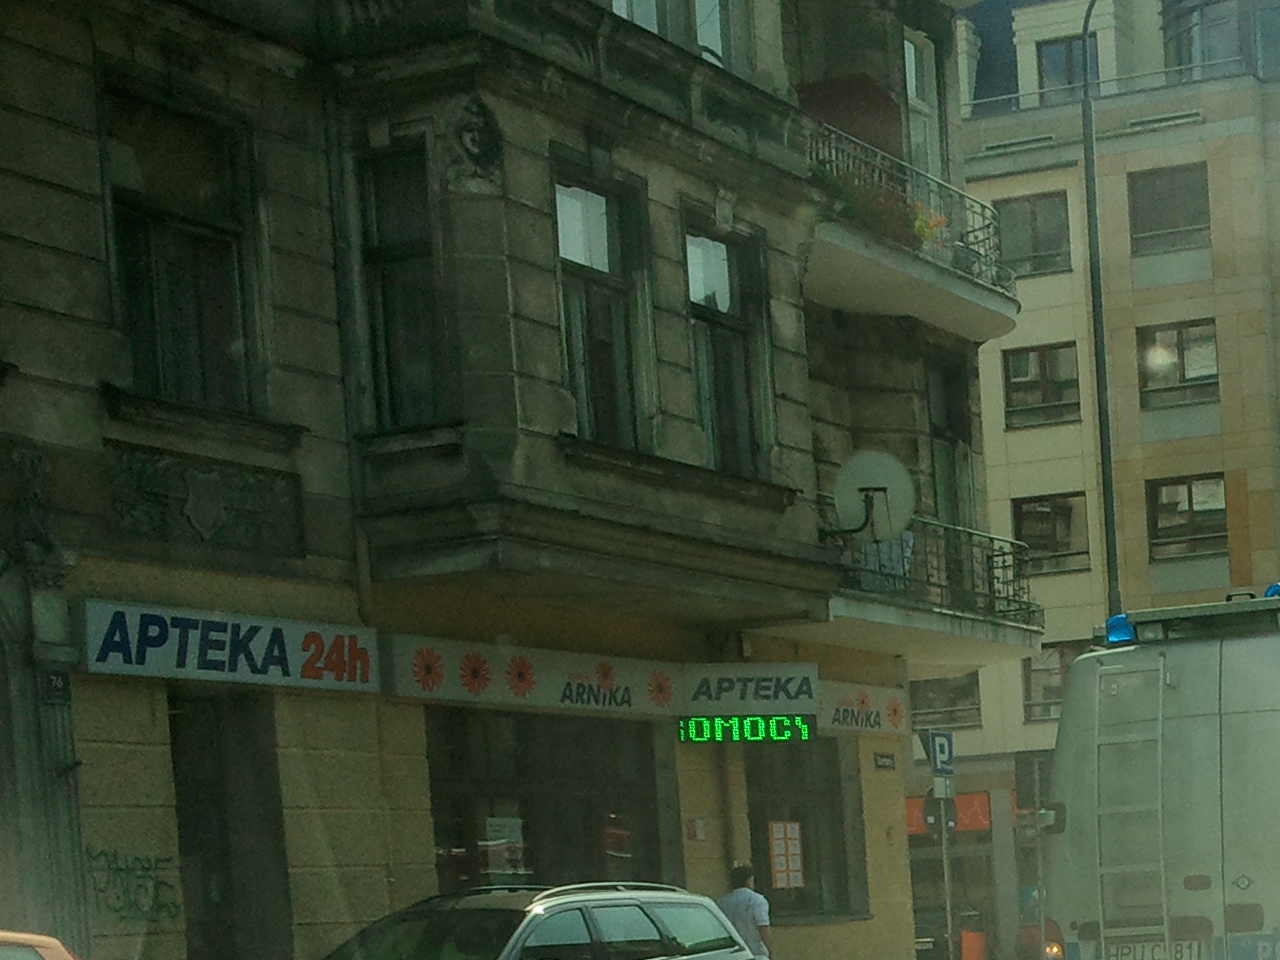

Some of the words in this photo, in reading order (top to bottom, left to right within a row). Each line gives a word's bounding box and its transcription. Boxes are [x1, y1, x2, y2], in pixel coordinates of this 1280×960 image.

[95, 610, 291, 678] APTEKA
[300, 630, 370, 683] 24h
[691, 676, 814, 701] APTEKA
[934, 736, 949, 769] P
